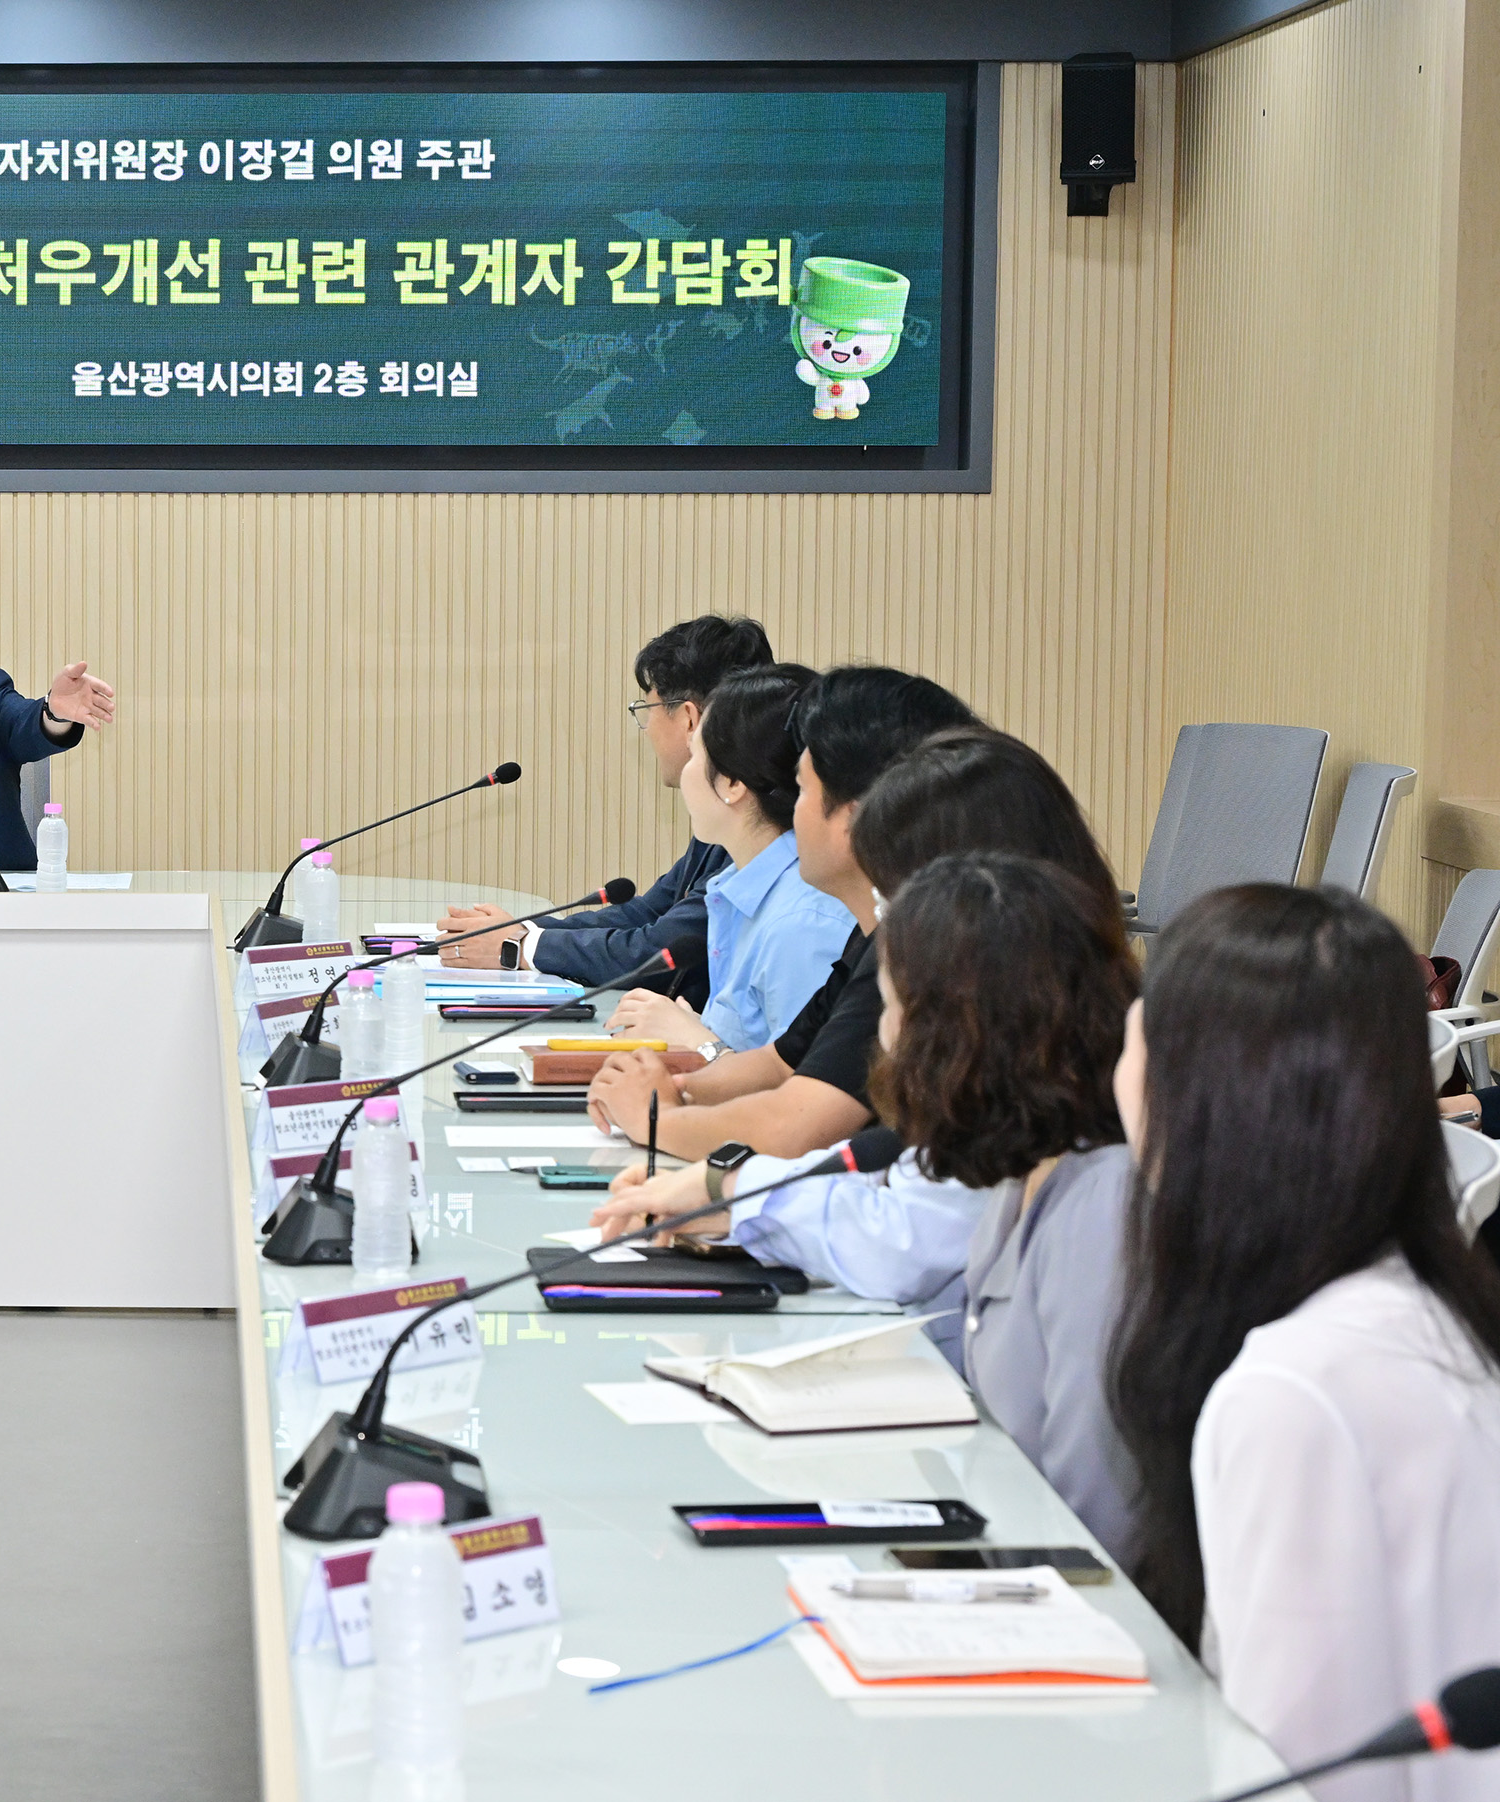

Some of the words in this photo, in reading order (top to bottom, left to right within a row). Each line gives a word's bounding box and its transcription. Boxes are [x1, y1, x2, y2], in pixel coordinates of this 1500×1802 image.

[199, 139, 314, 181] 이장걸
[327, 139, 403, 181] 의원
[416, 139, 496, 181] 주관
[244, 237, 366, 304] 관련
[393, 237, 584, 306] 관계자
[606, 237, 792, 306] 간담회
[71, 360, 303, 398] 울산광역시의회
[313, 360, 368, 398] 2층
[379, 360, 478, 398] 회의실
